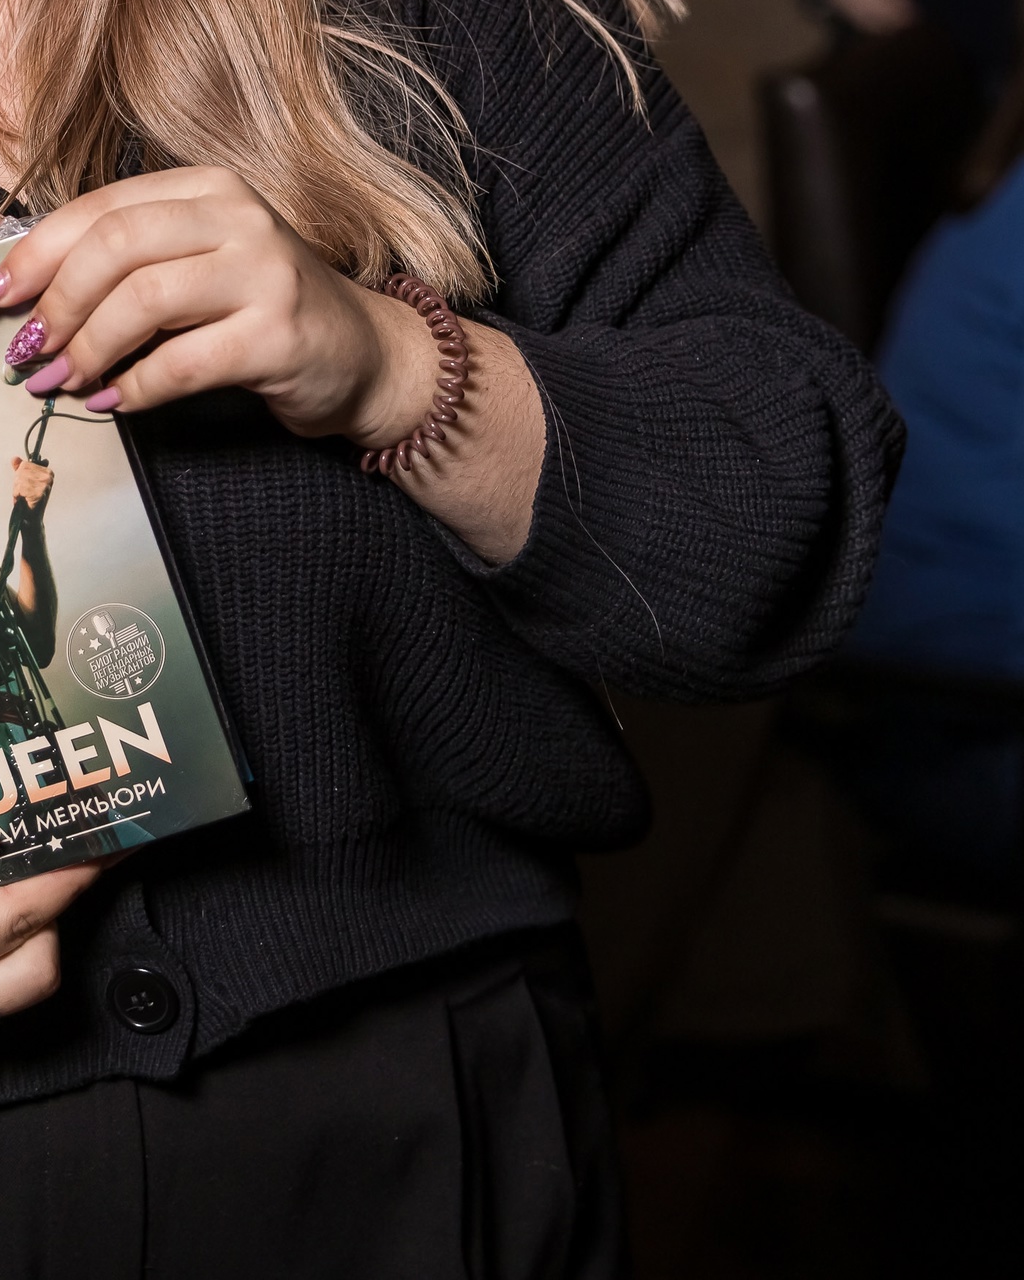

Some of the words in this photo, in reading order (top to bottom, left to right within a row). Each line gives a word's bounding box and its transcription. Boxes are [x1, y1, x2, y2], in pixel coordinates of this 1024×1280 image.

[88, 634, 150, 673] БИОГРАФИИ
[92, 644, 154, 682] ЛЕГЕНДАРНЫХ
[95, 653, 156, 690] МУЗЫКАНТОВ
[36, 776, 167, 834] МЕРКЬЮРИ
